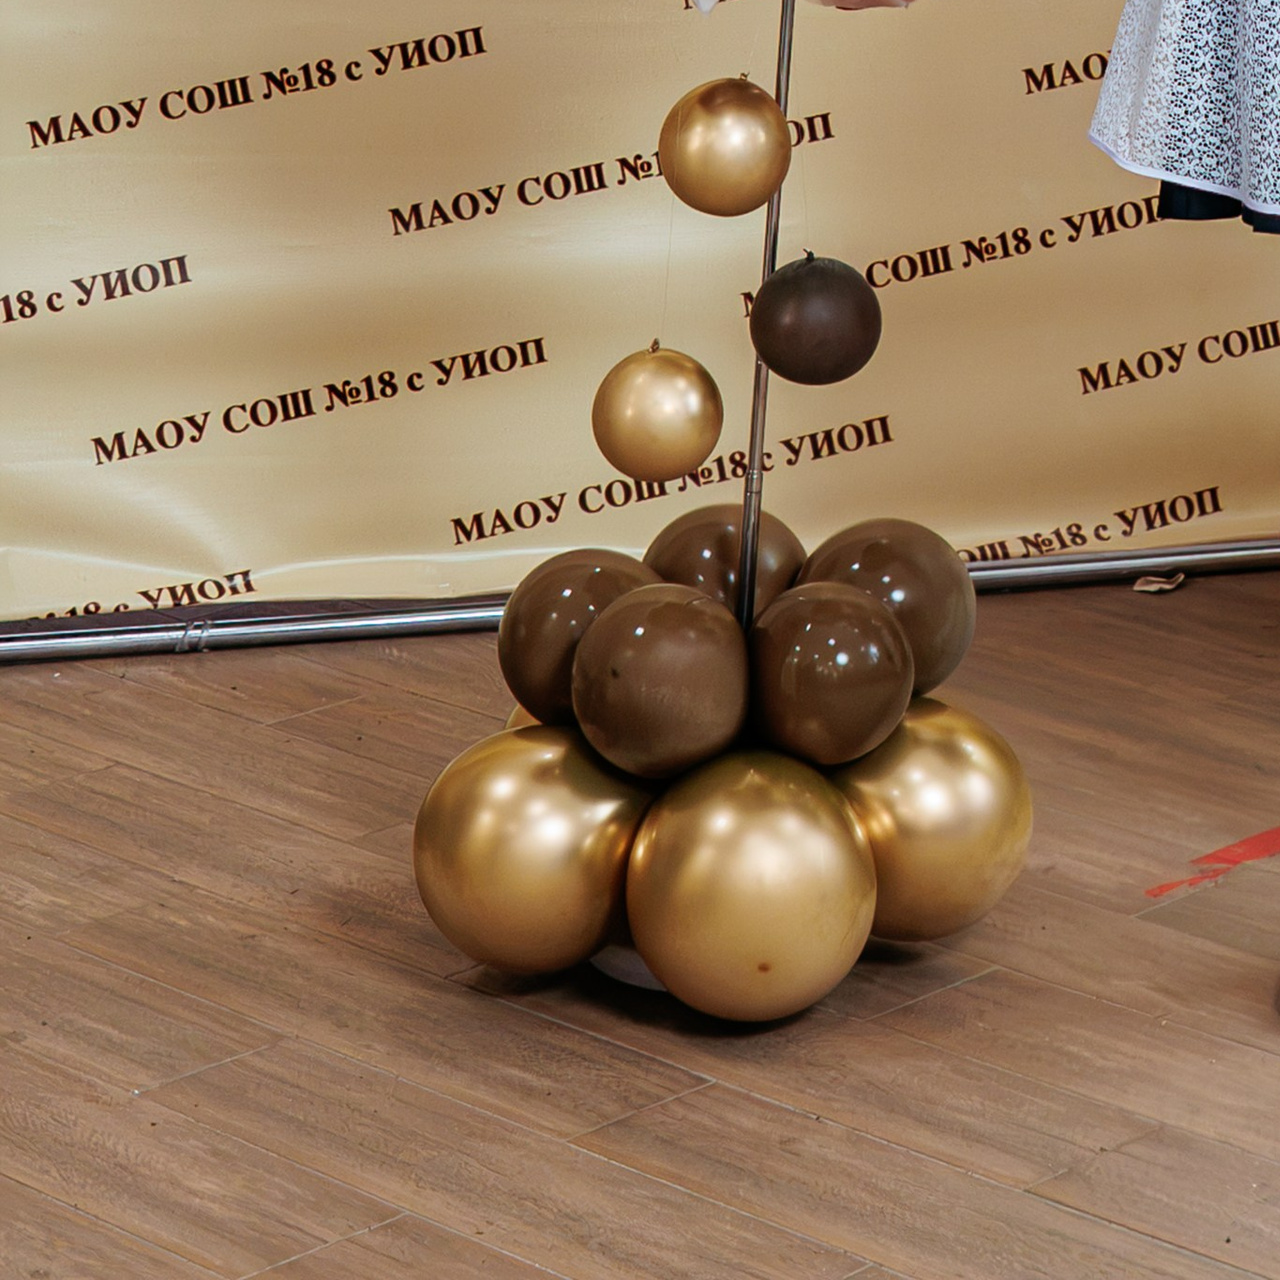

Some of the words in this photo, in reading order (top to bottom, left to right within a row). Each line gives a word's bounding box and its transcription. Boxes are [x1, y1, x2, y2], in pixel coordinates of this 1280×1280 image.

[26, 97, 148, 149] МАОУ
[159, 75, 254, 120] СОШ
[260, 58, 337, 100] №18
[344, 61, 363, 81] с
[368, 26, 487, 76] УИОП
[1021, 50, 1110, 95] МАО
[388, 184, 506, 236] МАОУ
[516, 162, 608, 206] СОШ
[46, 292, 65, 313] с
[70, 254, 192, 307] УИОП
[865, 244, 954, 289] СОШ
[960, 227, 1032, 269] №18
[1039, 228, 1057, 249] с
[91, 411, 211, 465] МАОУ
[222, 388, 317, 434] СОШ
[323, 370, 399, 412] №18
[406, 372, 425, 392] с
[429, 337, 548, 386] УИОП
[1078, 342, 1187, 395] МАОУ
[450, 492, 567, 546] МАОУ
[779, 415, 893, 466] УИОП
[1019, 522, 1088, 559] №18
[1093, 524, 1111, 542] с
[1113, 486, 1223, 537] УИОП
